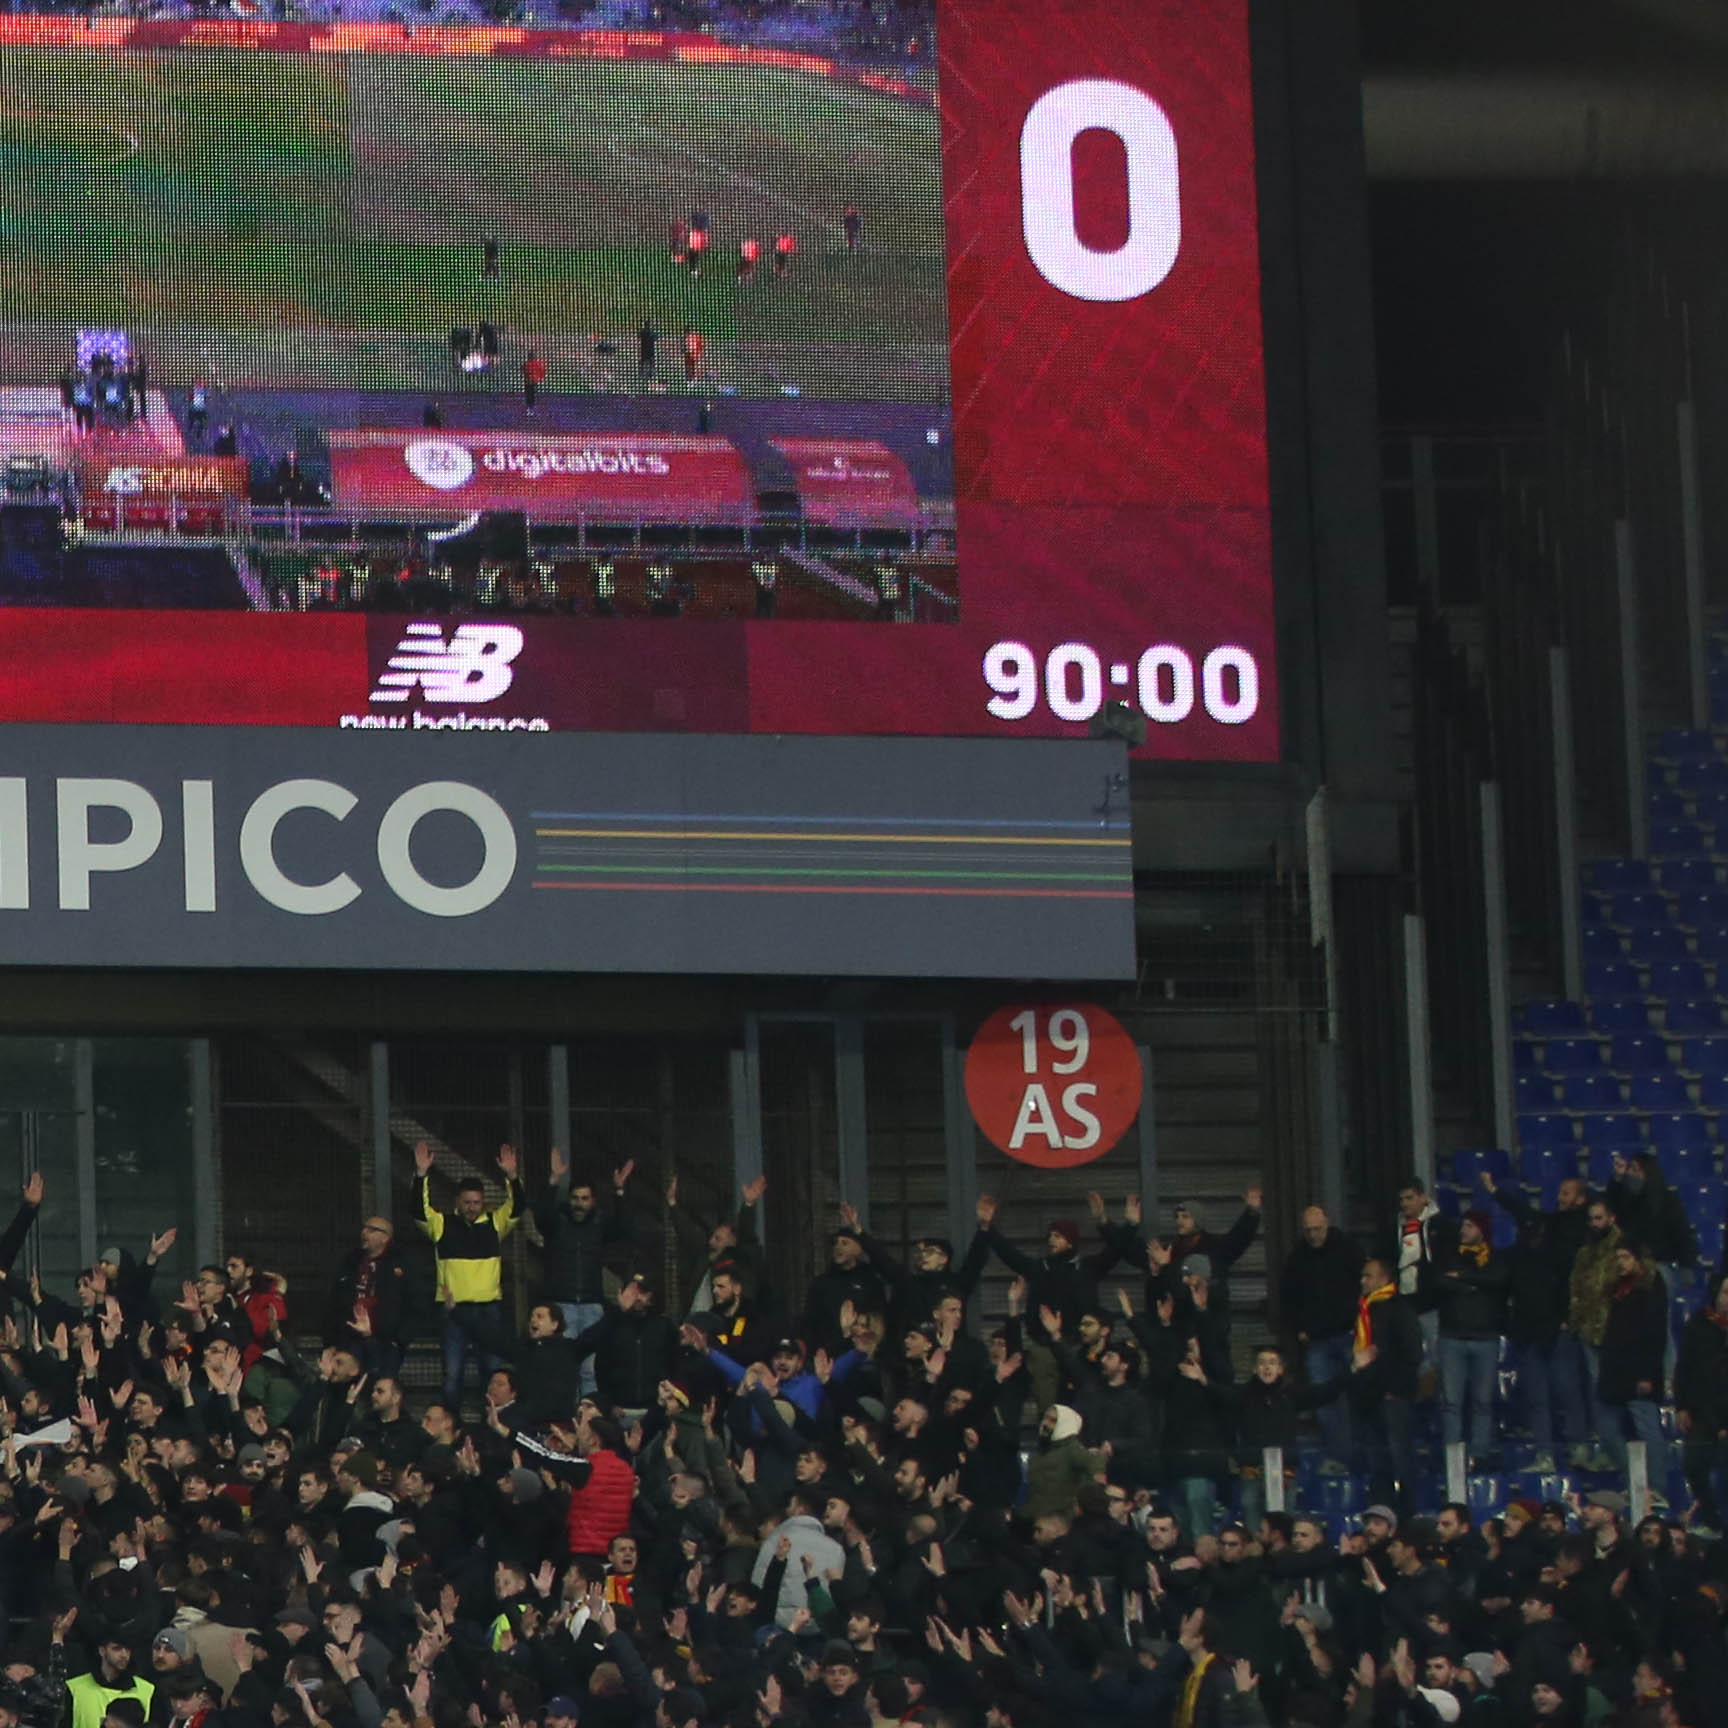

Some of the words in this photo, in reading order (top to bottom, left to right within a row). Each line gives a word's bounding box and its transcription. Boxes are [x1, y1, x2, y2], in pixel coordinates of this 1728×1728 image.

[1019, 76, 1182, 302] 0
[1009, 1010, 1089, 1074] 19
[1009, 1083, 1101, 1149] AS
